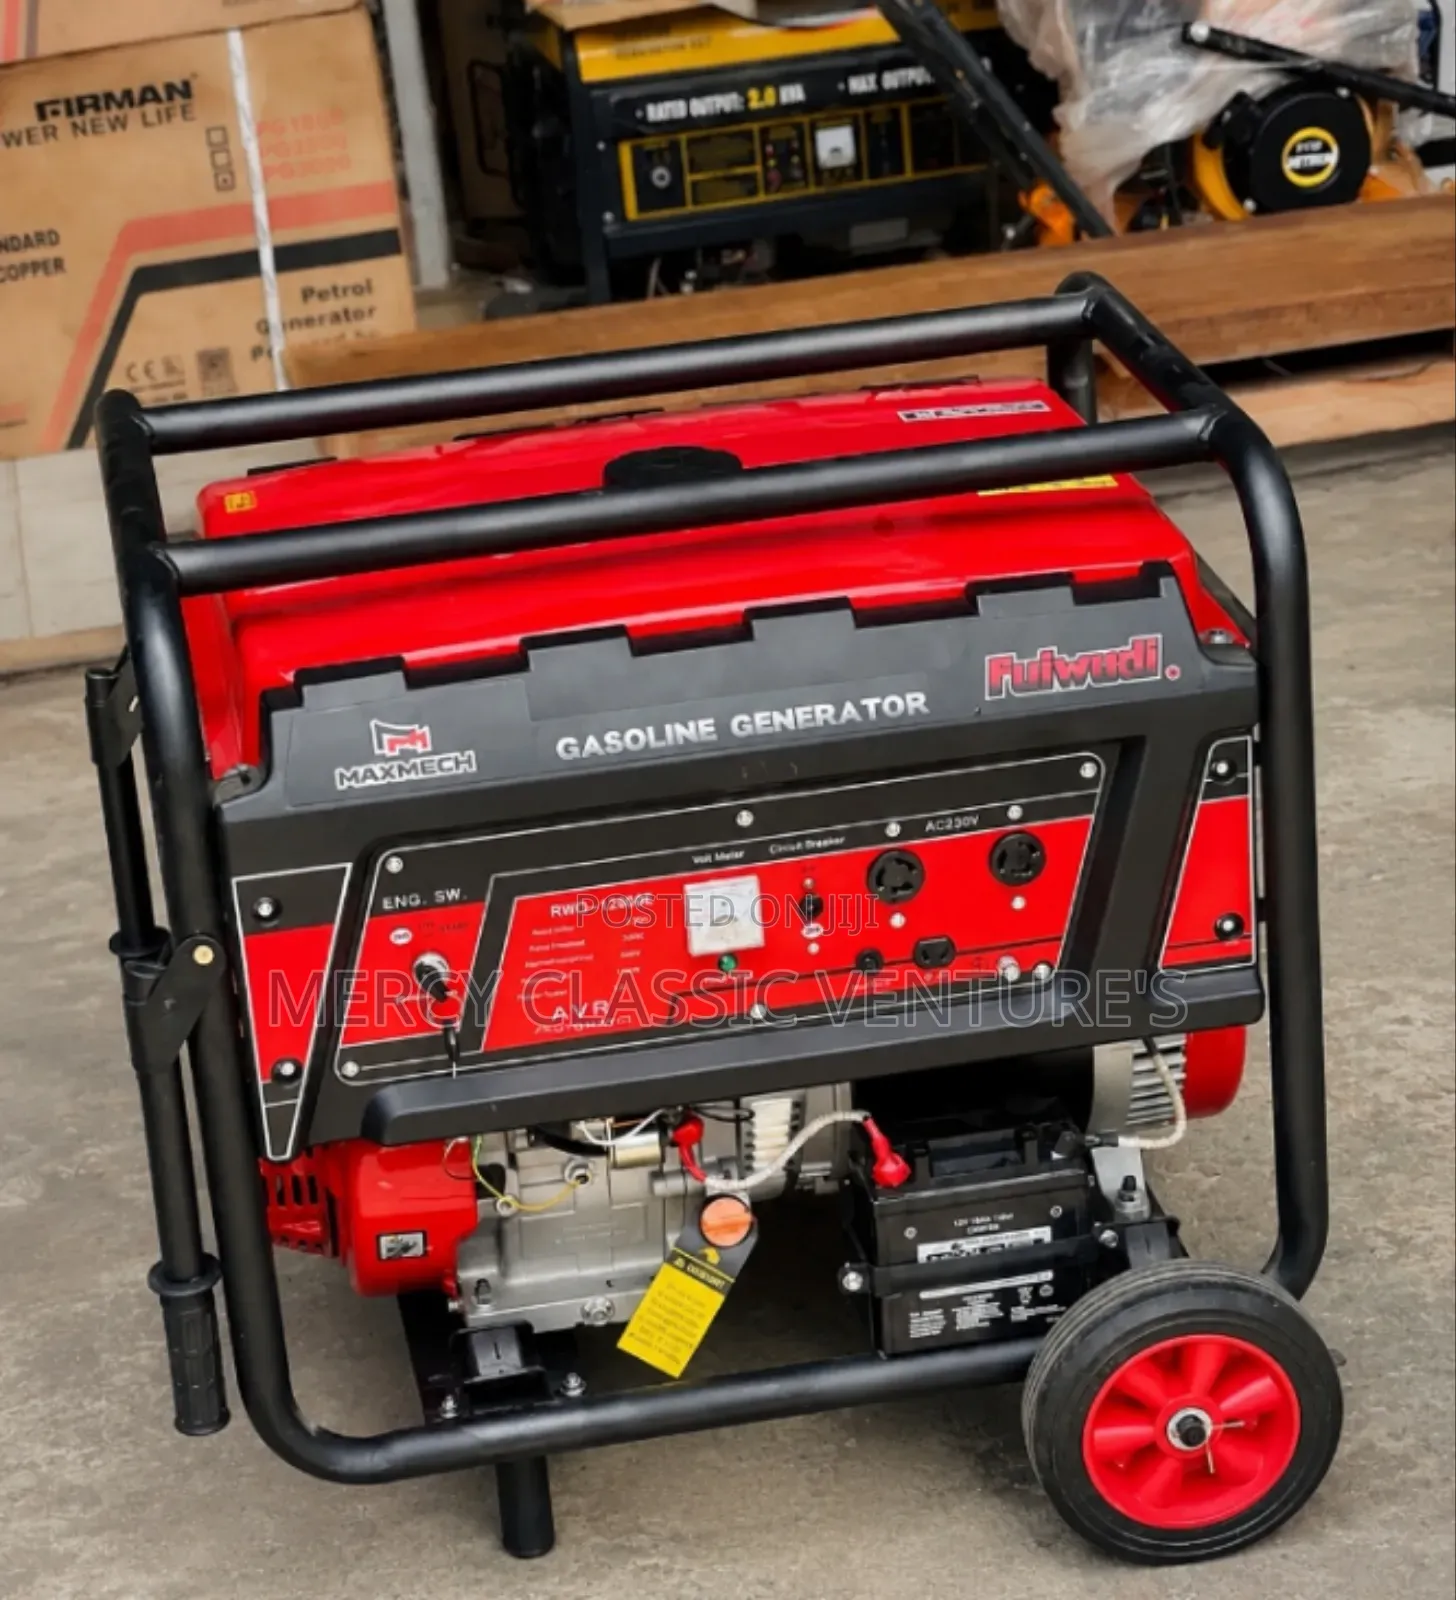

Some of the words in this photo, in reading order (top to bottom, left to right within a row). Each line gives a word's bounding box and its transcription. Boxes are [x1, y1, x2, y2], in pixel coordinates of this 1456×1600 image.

[35, 79, 193, 122] FIRMAN
[748, 87, 777, 110] 2.0
[71, 113, 128, 138] NEW
[140, 103, 196, 128] LIFE
[301, 278, 373, 304] Petrol
[256, 304, 377, 336] Gnerator
[556, 718, 718, 761] GASOLINE
[730, 691, 930, 738] GENERATOR
[335, 750, 477, 791] MAXMECH
[925, 814, 980, 833] AC230V
[382, 892, 427, 911] ENG.
